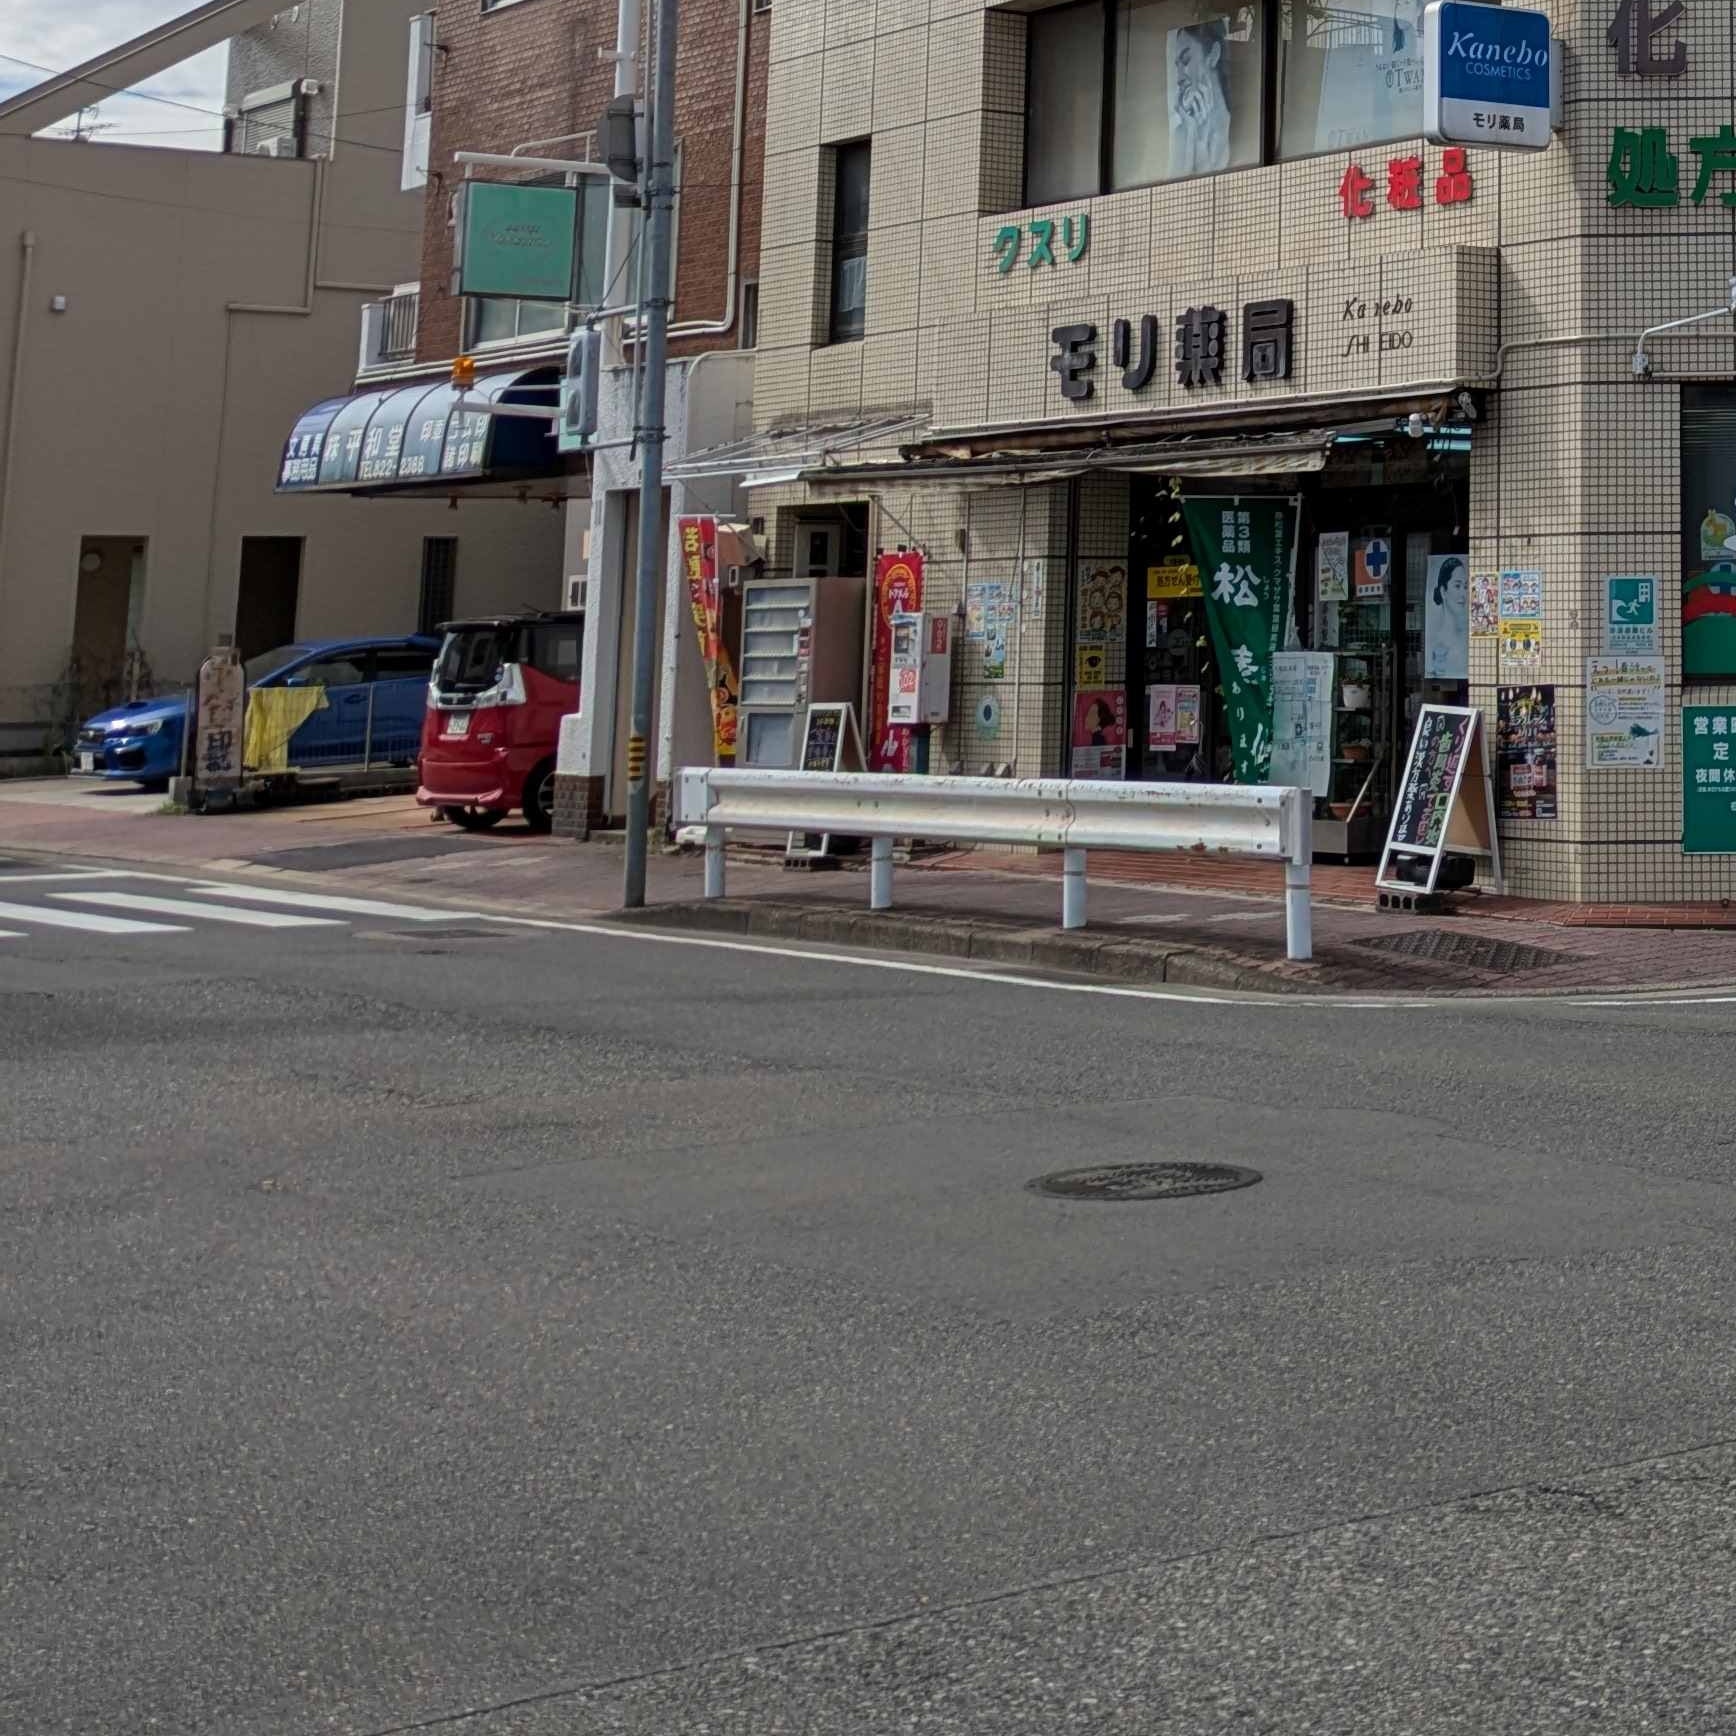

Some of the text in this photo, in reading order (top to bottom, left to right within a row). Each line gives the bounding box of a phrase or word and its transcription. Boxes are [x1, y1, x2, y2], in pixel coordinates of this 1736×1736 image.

[1447, 31, 1548, 67] Kanebo
[1465, 62, 1532, 81] COSMETICS
[1472, 112, 1525, 133] モリ薬局
[1338, 147, 1474, 220] 化粧品
[992, 213, 1089, 275] クスリ
[1050, 297, 1295, 401] モリ薬局
